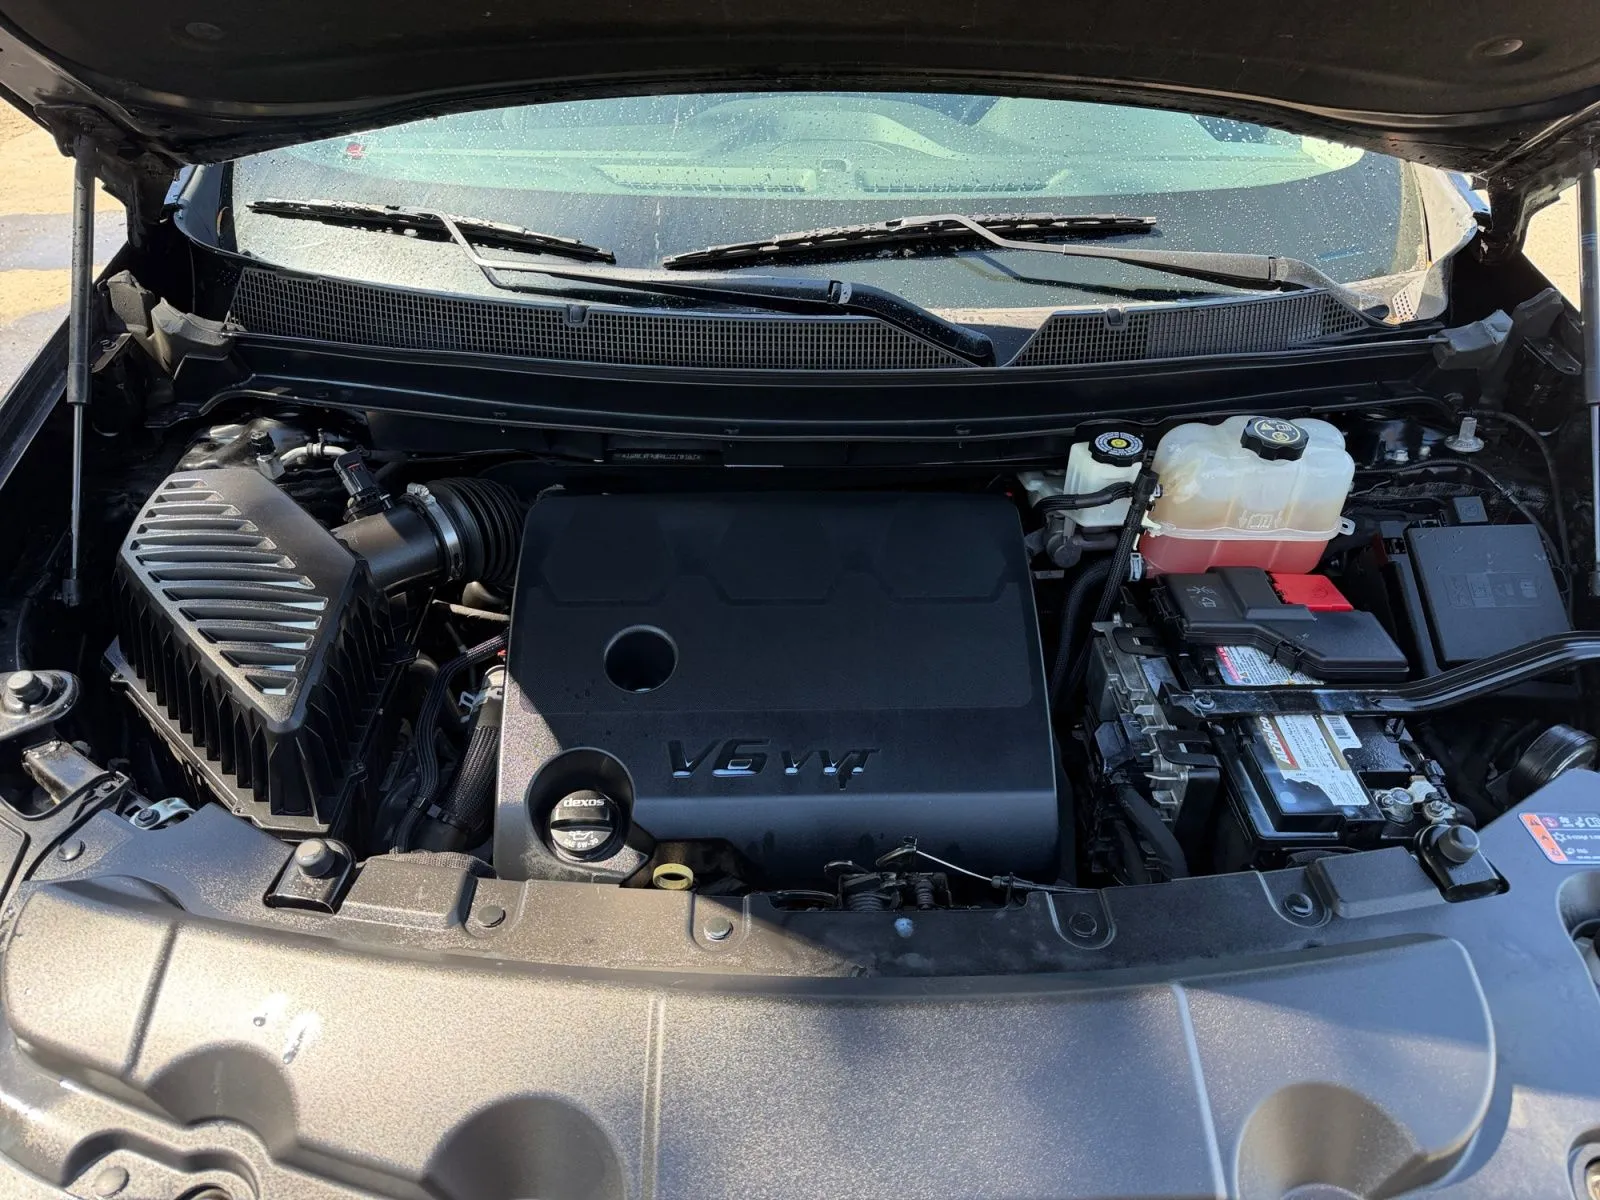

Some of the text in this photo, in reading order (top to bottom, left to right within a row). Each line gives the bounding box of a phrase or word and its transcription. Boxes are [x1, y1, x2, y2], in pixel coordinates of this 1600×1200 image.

[667, 738, 881, 778] V6 VVT
[563, 797, 605, 808] dexos
